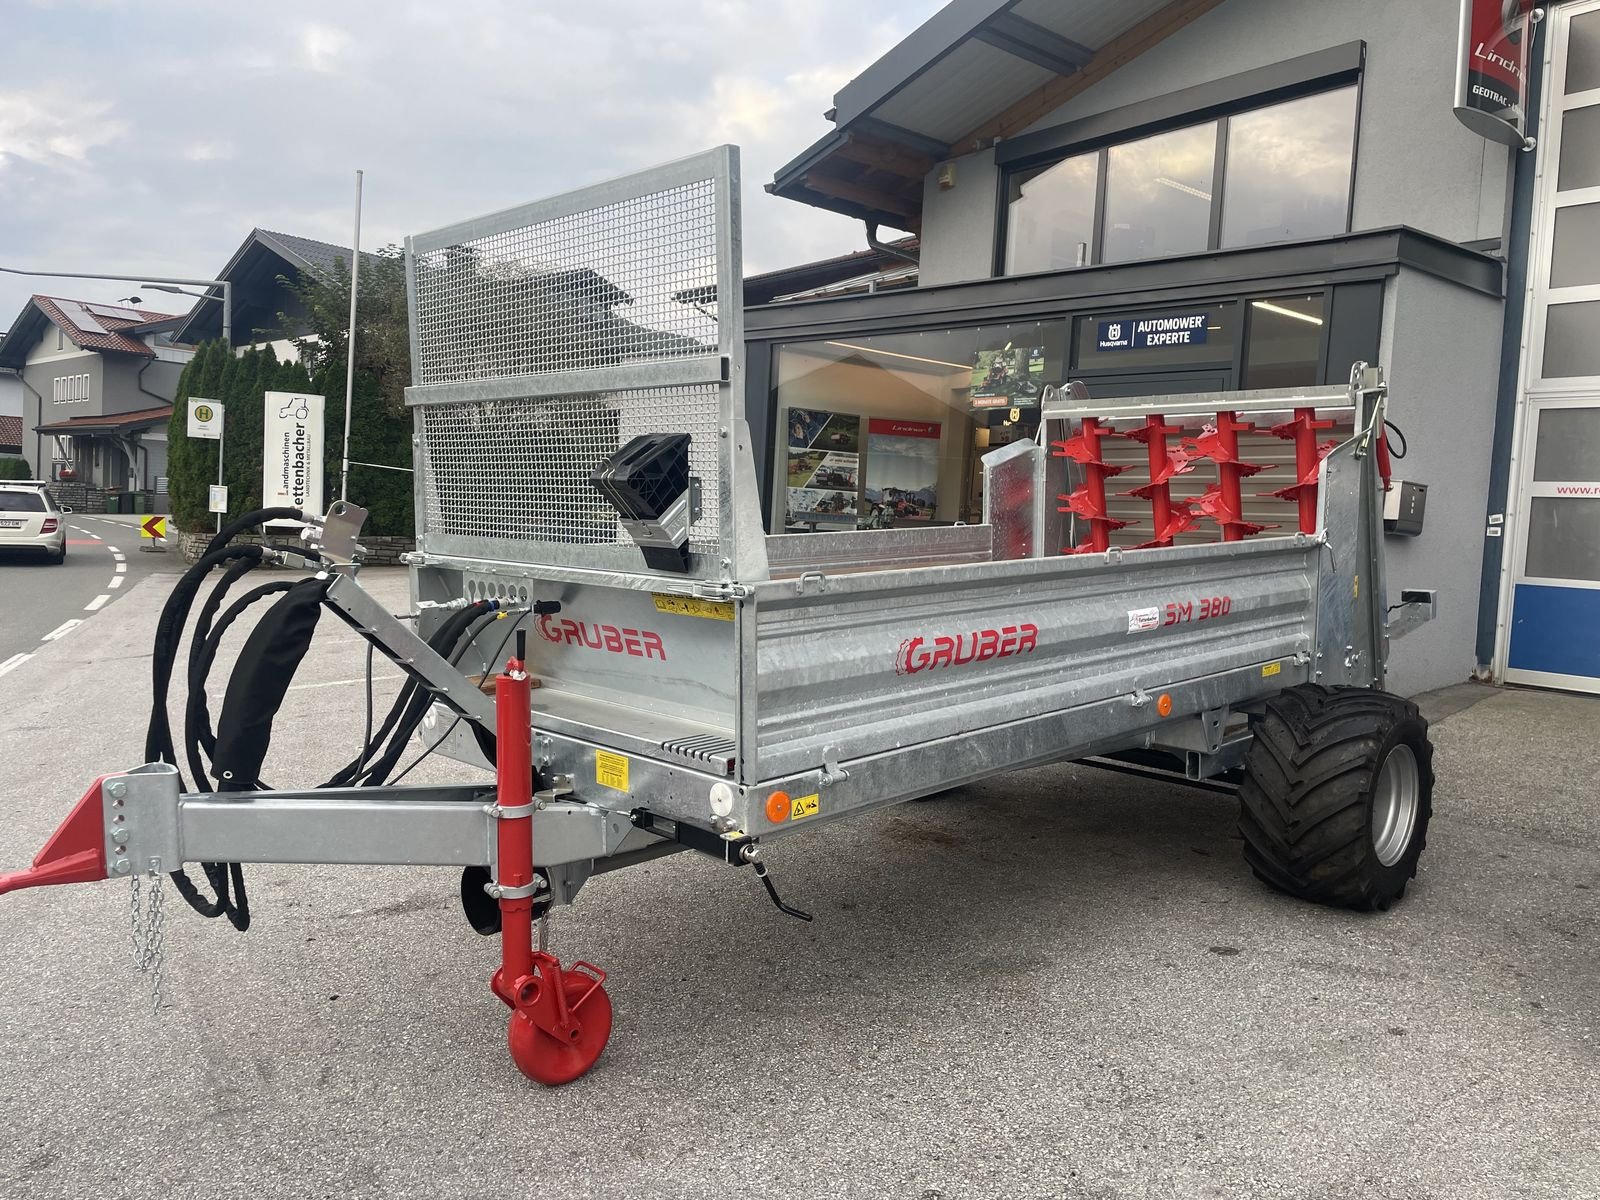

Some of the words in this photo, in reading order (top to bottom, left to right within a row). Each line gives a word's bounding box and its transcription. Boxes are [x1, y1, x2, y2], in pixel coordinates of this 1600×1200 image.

[1472, 84, 1508, 107] GEOTRAC
[1137, 316, 1202, 333] AUTOMOWER
[1146, 331, 1191, 346] EXPERTE
[199, 408, 209, 420] H
[278, 432, 290, 496] Landmaschinen
[1164, 601, 1193, 626] SM
[1199, 596, 1231, 620] 380
[535, 614, 666, 661] GRUBER
[896, 623, 1038, 676] GRUBER
